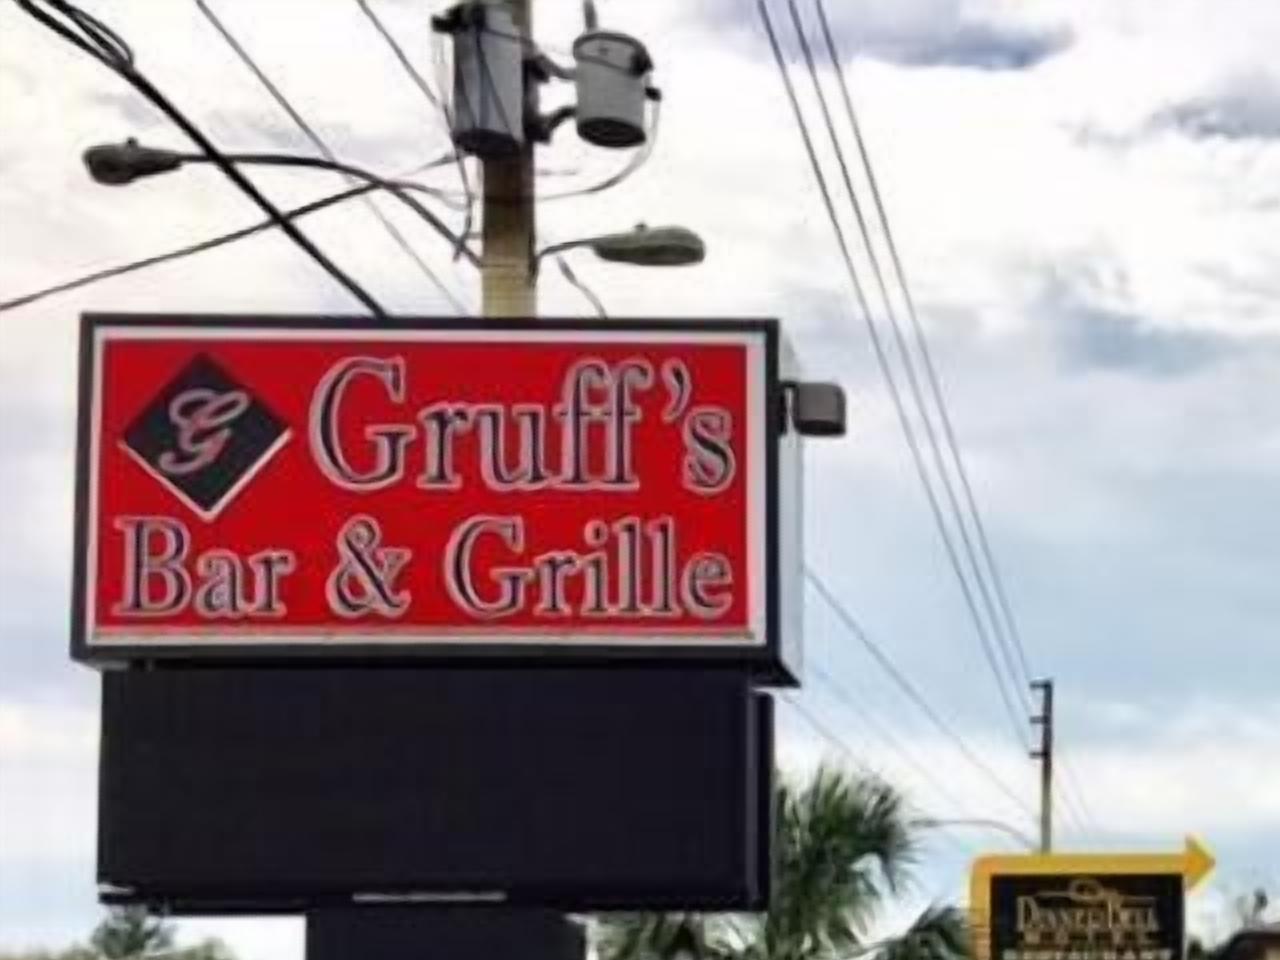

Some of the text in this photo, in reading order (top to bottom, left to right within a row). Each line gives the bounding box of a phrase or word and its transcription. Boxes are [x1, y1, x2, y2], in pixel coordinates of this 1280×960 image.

[308, 355, 736, 495] Gruff's
[112, 515, 734, 621] Bar & Grille
